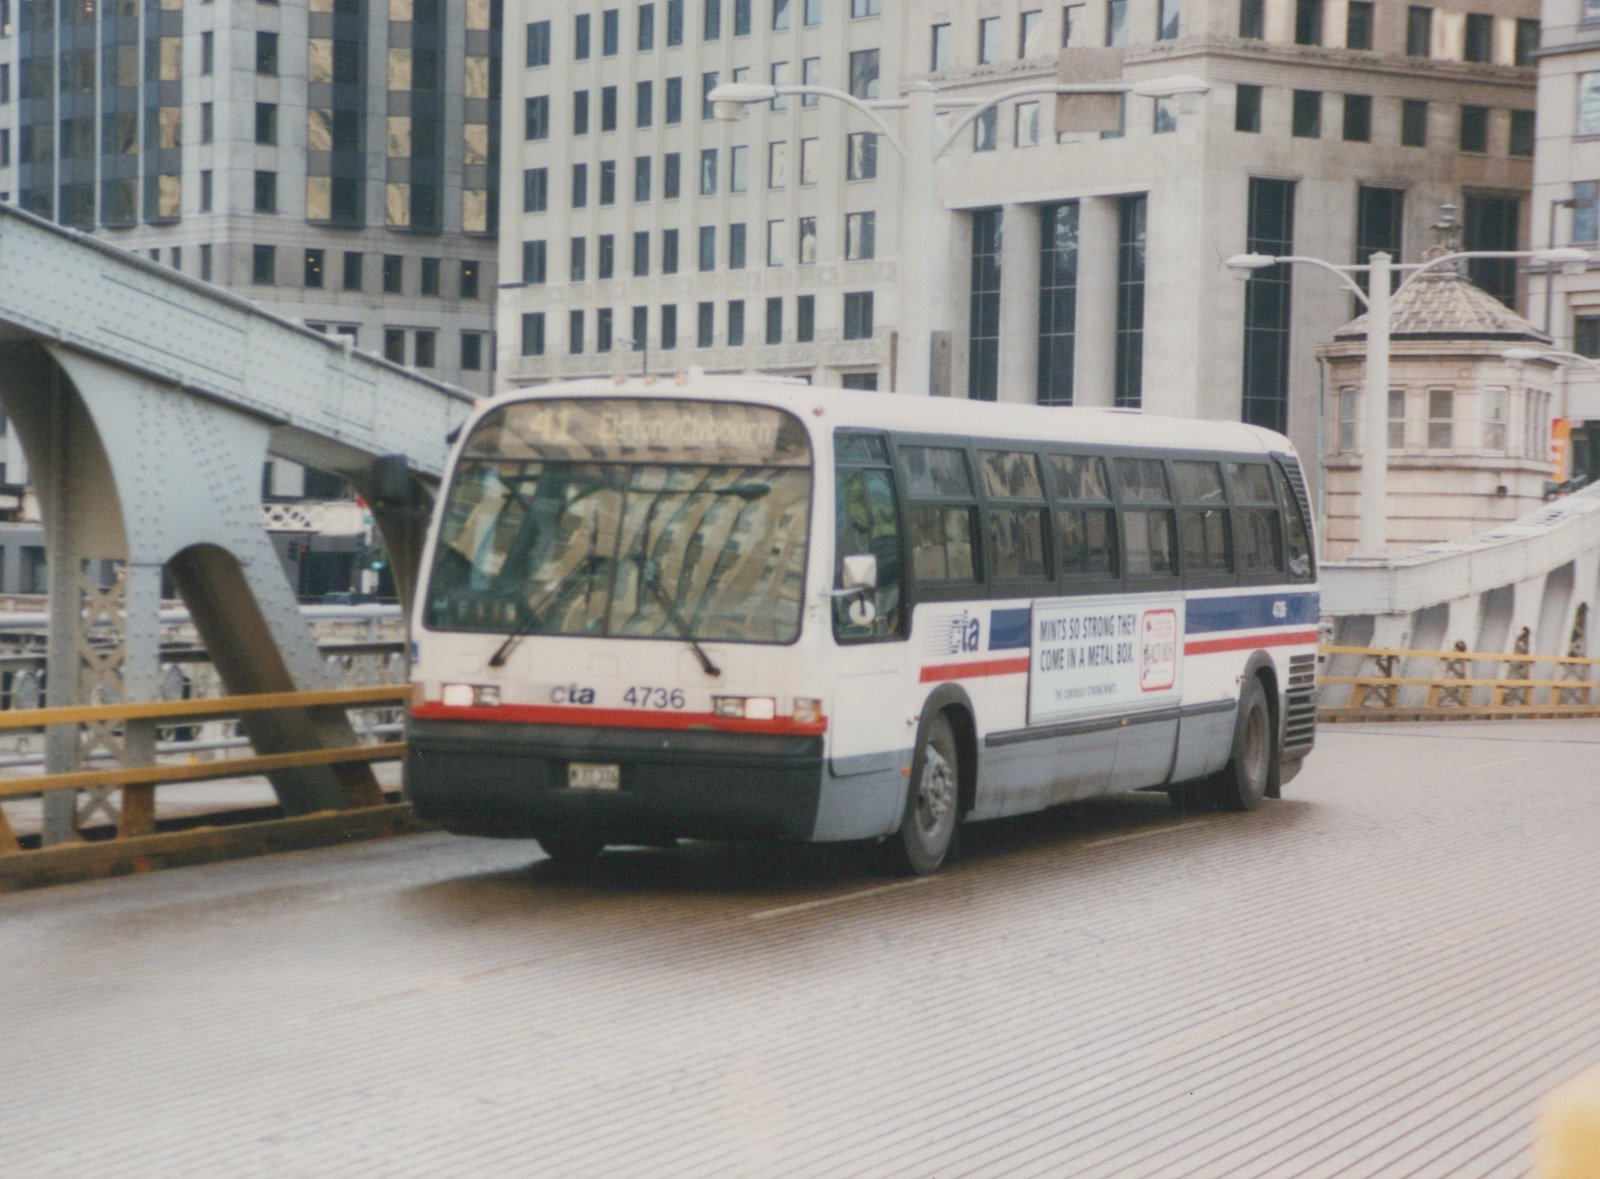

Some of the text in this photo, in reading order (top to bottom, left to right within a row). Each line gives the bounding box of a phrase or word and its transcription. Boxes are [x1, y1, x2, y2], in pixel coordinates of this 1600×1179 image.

[1039, 618, 1067, 641] MINTS
[1069, 617, 1080, 640] SO
[1082, 615, 1115, 638] STRONG
[1117, 614, 1137, 635] THEY
[1040, 642, 1135, 672] COME IN A METAL BOX.
[550, 682, 686, 709] cta 4736
